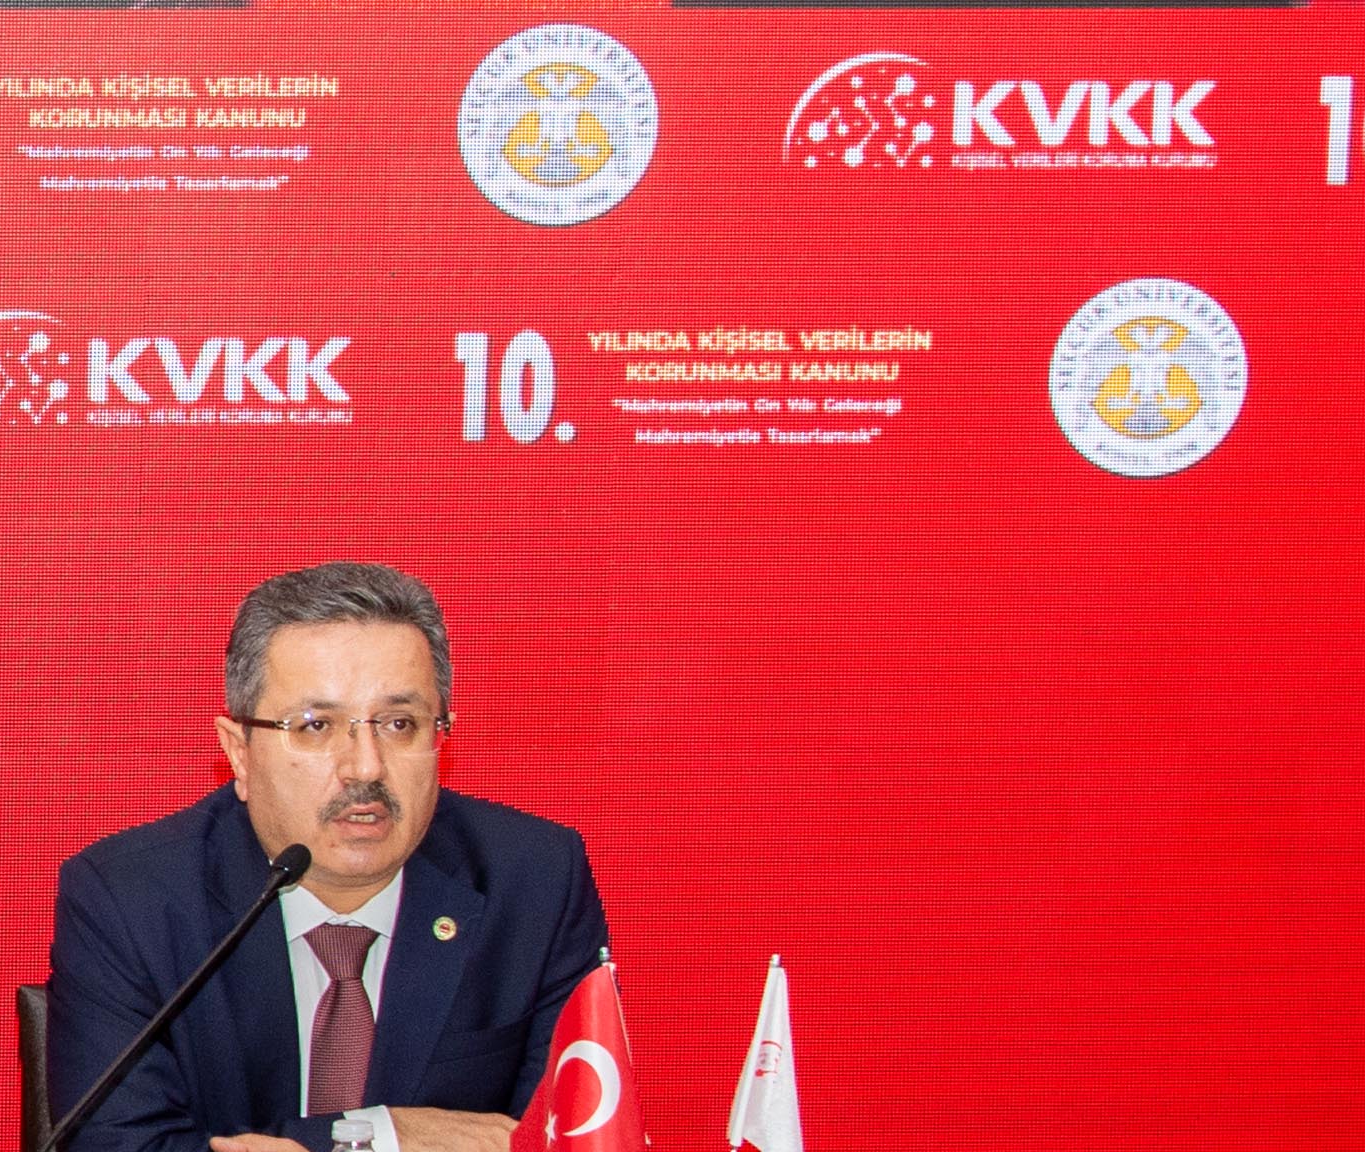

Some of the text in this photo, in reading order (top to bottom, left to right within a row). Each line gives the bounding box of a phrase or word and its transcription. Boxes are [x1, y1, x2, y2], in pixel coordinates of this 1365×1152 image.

[102, 74, 196, 101] KİŞİSEL
[205, 74, 338, 97] VERİLERİN
[29, 108, 306, 128] KORUNMASI KANUNU
[952, 81, 1214, 146] KVKK
[588, 327, 932, 354] YILINDA KİŞİSEL VERİLERİN
[88, 337, 350, 404] KVKK
[626, 362, 899, 382] KORUNMASI KANUNU
[455, 329, 575, 443] 10.
